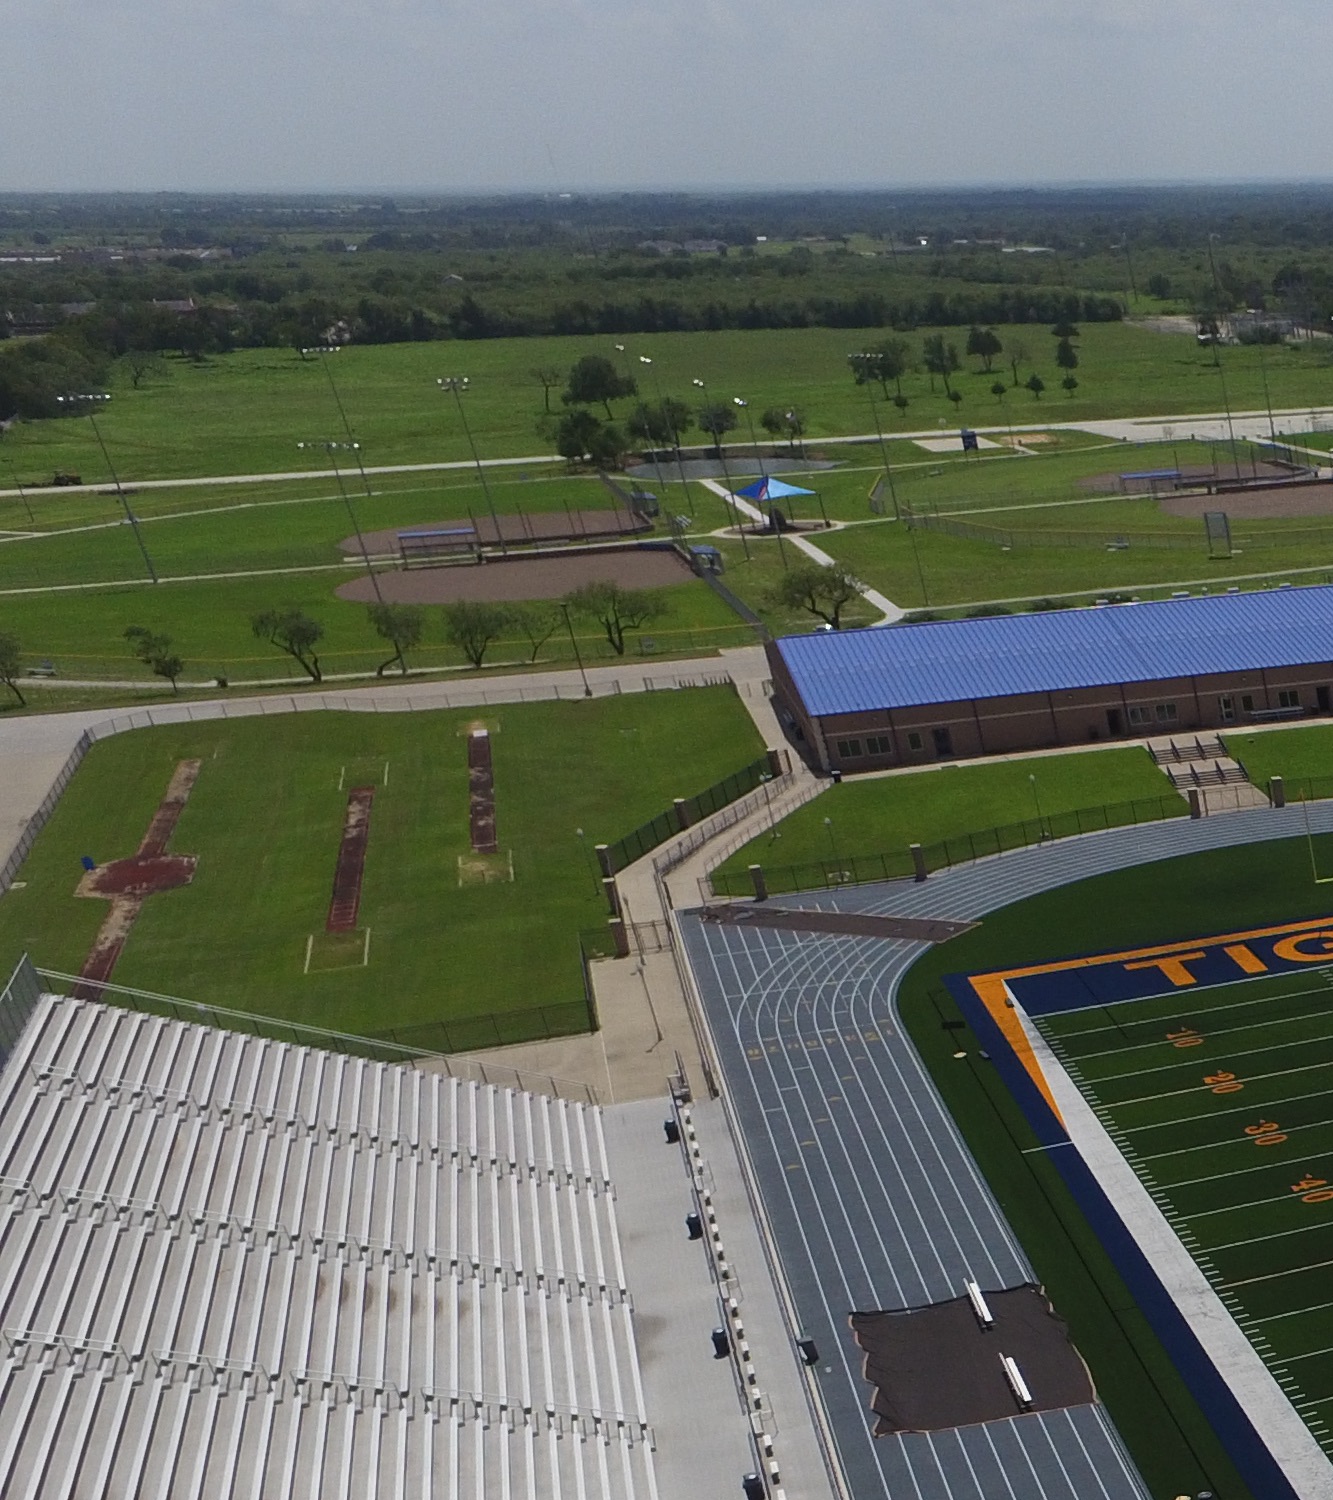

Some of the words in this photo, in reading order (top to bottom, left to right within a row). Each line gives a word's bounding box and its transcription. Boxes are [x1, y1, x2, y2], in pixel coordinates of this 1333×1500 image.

[1166, 1029, 1203, 1049] 10
[1203, 1071, 1244, 1095] 20
[1244, 1122, 1288, 1146] 30
